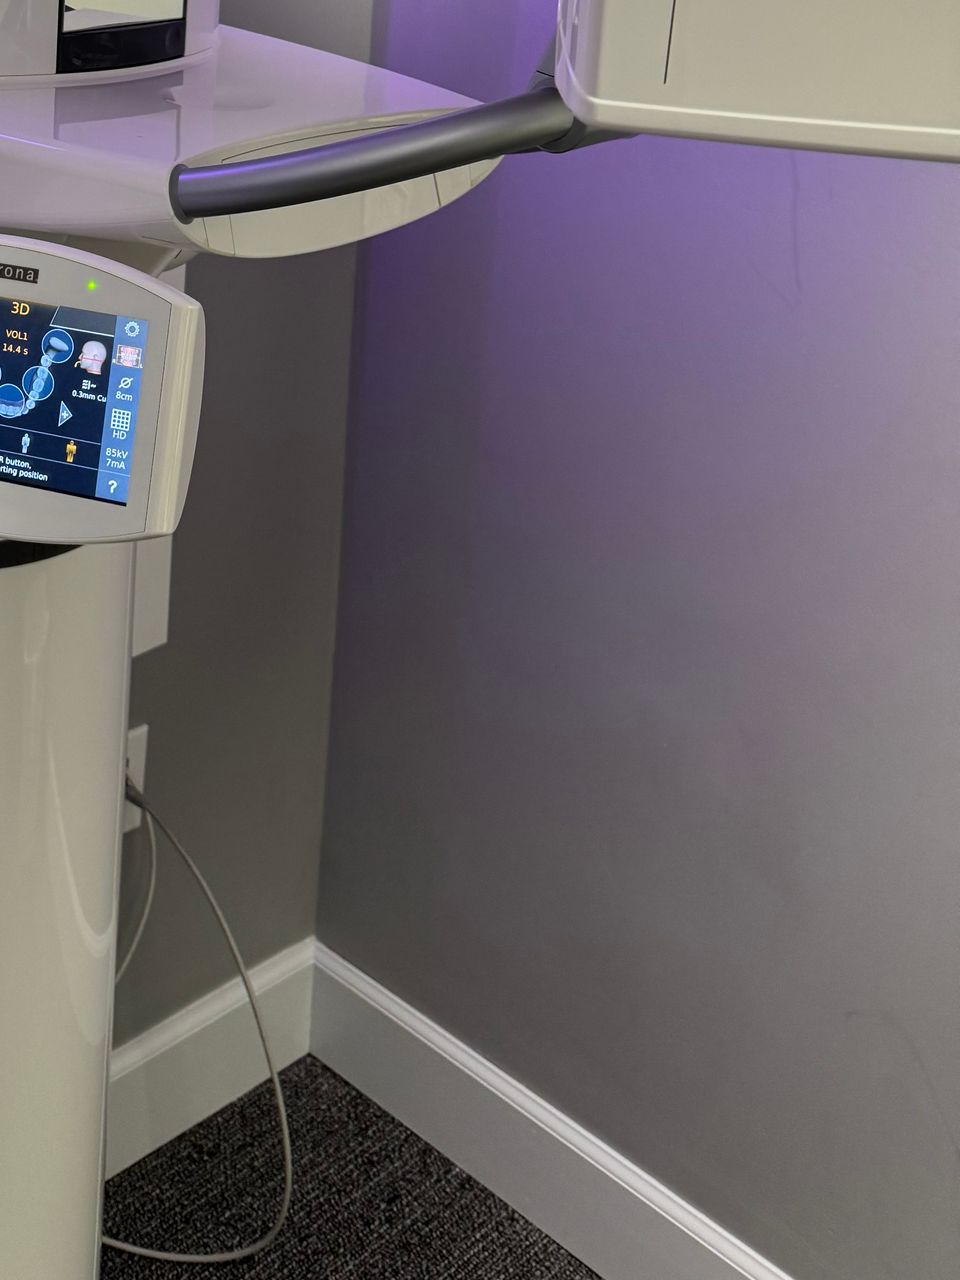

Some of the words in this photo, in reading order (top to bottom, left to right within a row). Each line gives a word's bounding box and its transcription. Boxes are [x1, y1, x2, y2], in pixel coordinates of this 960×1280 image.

[10, 301, 30, 316] 3D
[5, 328, 28, 341] VOL1
[2, 342, 21, 354] 14.4
[71, 390, 96, 401] 0.3mm
[115, 391, 133, 402] 8cm
[112, 430, 127, 440] HD
[105, 448, 129, 459] 85kV
[5, 456, 32, 469] button,
[106, 459, 126, 470] 7mA
[19, 468, 48, 482] position
